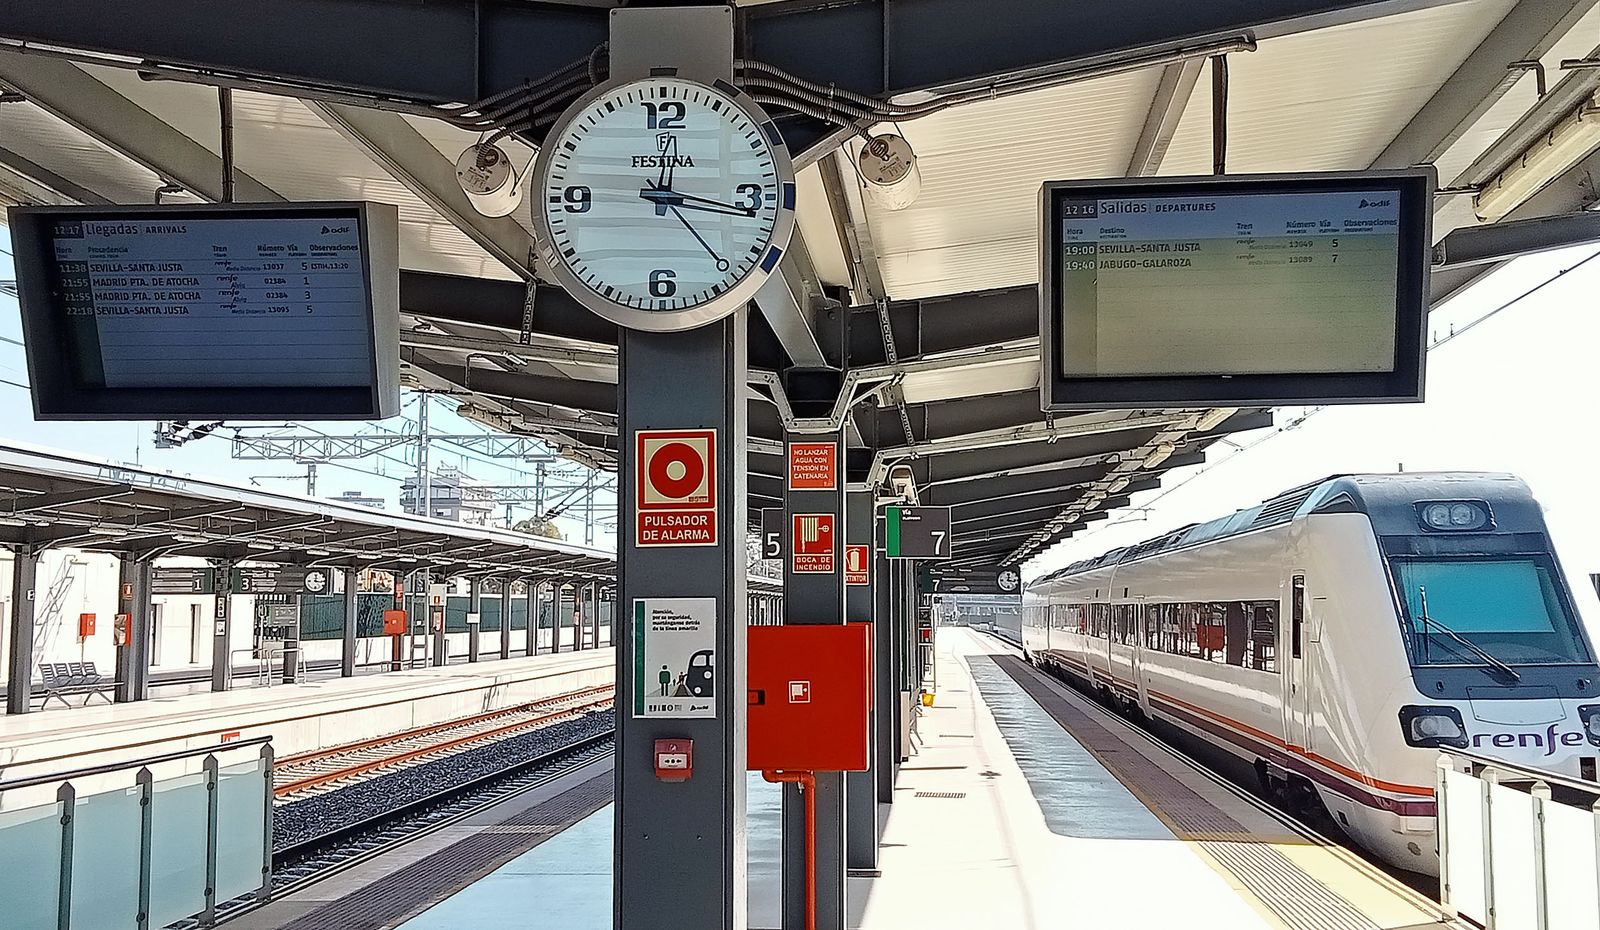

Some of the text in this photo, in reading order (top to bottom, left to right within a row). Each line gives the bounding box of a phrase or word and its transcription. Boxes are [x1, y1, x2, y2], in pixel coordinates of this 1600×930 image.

[641, 101, 686, 130] 12
[631, 155, 694, 168] FESTINA
[564, 185, 591, 213] 9
[735, 183, 762, 211] 3
[1100, 201, 1216, 214] Salidas DEPARTURES
[1286, 220, 1316, 228] Número
[1344, 218, 1398, 226] Observaciones
[86, 224, 188, 237] Llegadas ARRIVALS
[1065, 242, 1201, 256] 19:00 SEVILLA-SANTA JUSTA
[1332, 238, 1339, 248] 5
[1332, 254, 1338, 262] 7
[90, 264, 156, 272] SEVILLA-SANTA
[158, 263, 184, 272] JUSTA
[302, 262, 308, 270] 5
[1066, 258, 1192, 271] 19:40 JABUGO-GALAROZA
[92, 278, 127, 286] MADRID
[130, 278, 150, 286] PTA.
[152, 278, 164, 286] DE
[166, 278, 200, 286] ATOCHA
[304, 276, 310, 285] 1
[649, 269, 677, 297] 6
[94, 292, 130, 300] MADRID
[132, 292, 152, 300] PTA.
[154, 292, 166, 300] DE
[168, 292, 202, 300] ATOCHA
[304, 290, 311, 300] 3
[66, 306, 190, 316] 22:18 SEVILLA-SANTA JUSTA
[306, 305, 313, 314] 5
[644, 516, 708, 527] PULSADOR
[642, 529, 710, 541] DE ALARMA
[767, 532, 780, 557] 5
[931, 531, 946, 555] 7
[194, 579, 202, 590] 1
[241, 578, 250, 590] 3
[932, 580, 940, 592] 7
[1472, 723, 1584, 757] renfe
